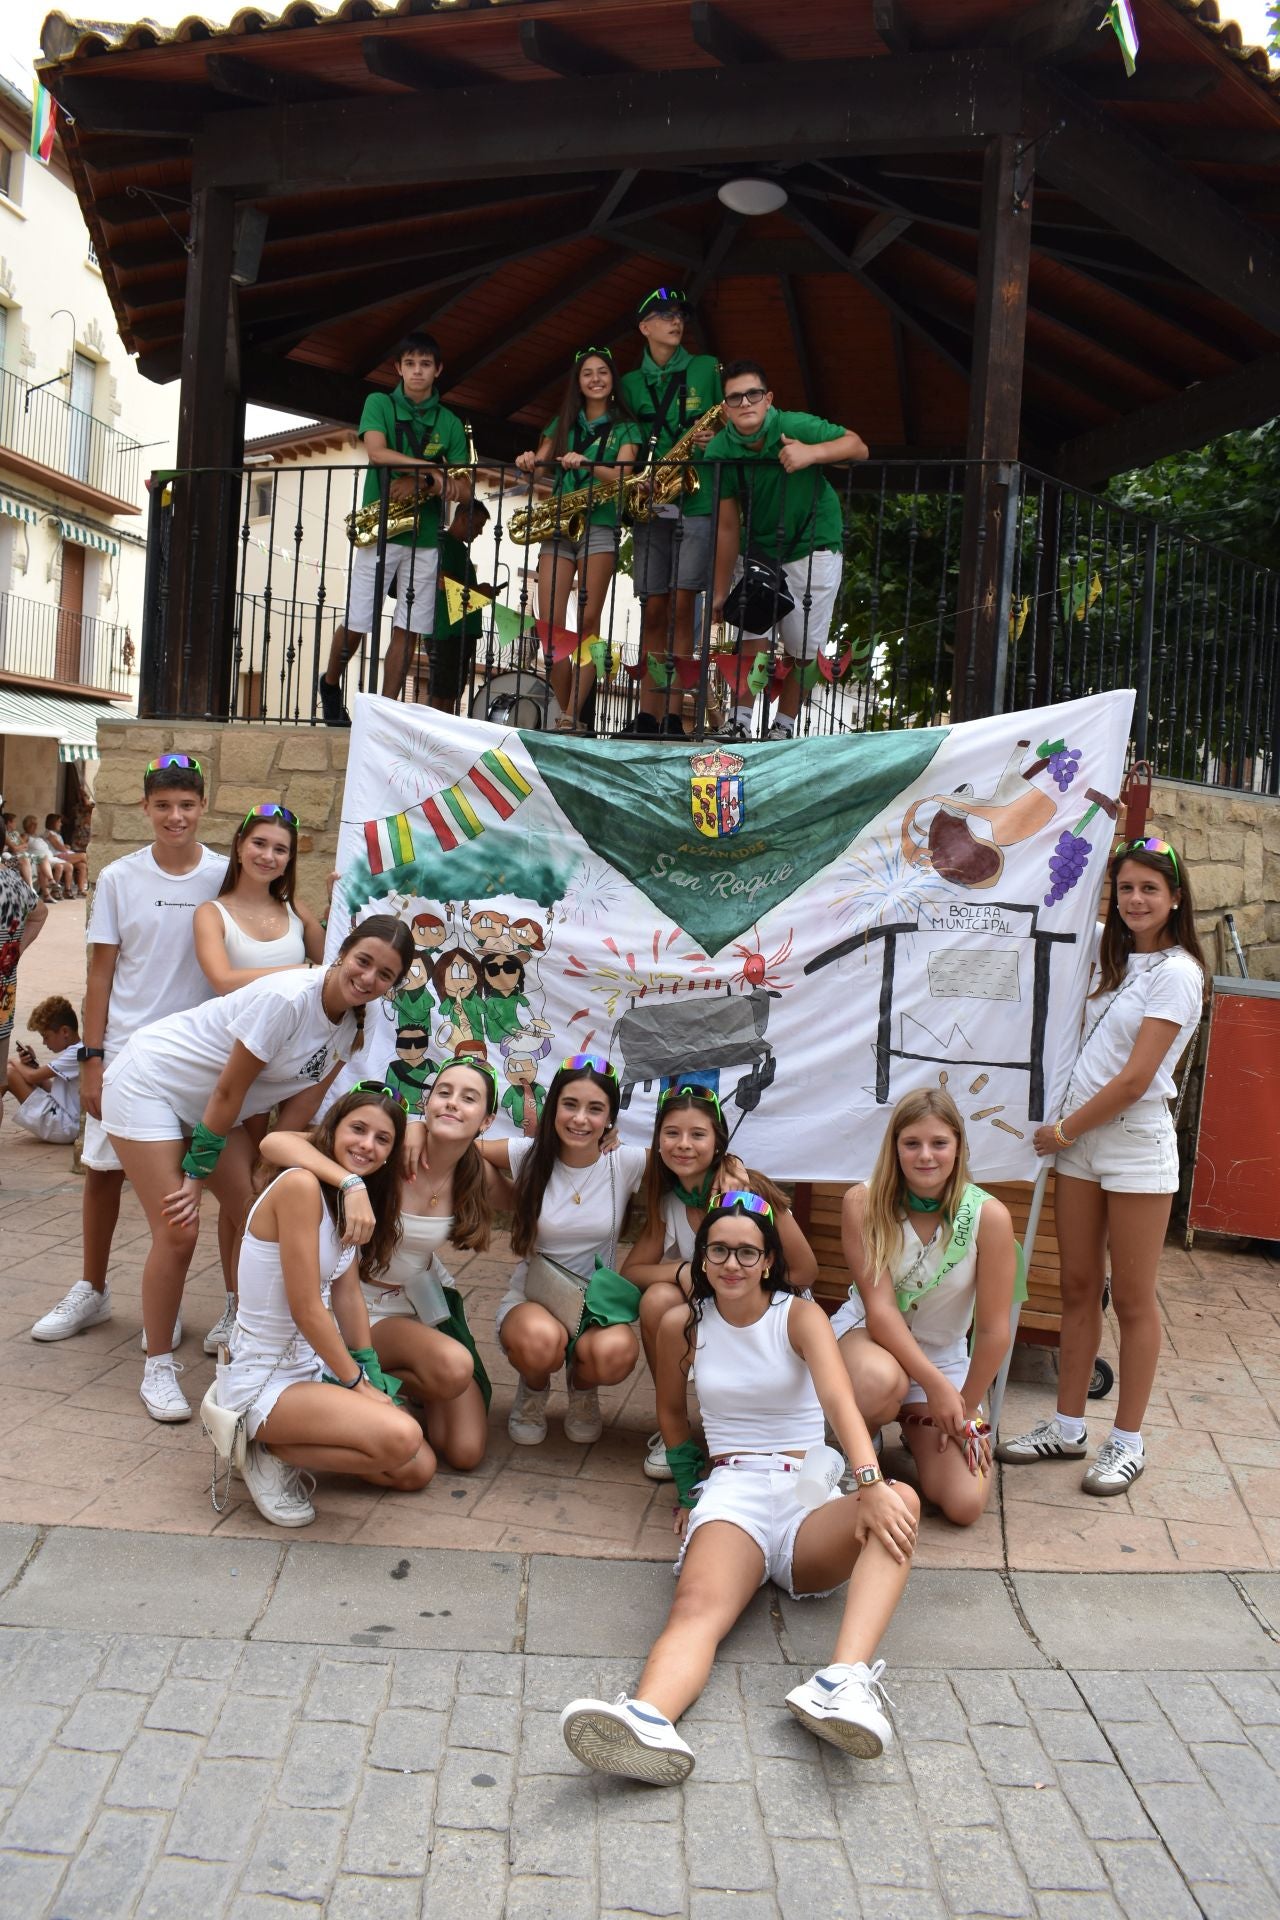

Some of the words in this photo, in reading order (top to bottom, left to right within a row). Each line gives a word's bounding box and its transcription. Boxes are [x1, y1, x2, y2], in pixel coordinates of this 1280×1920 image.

[651, 853, 702, 890] San
[710, 863, 794, 902] Roque
[155, 900, 196, 908] Champion
[949, 905, 1001, 918] BOLERA
[932, 918, 1013, 933] MUNICIPAL
